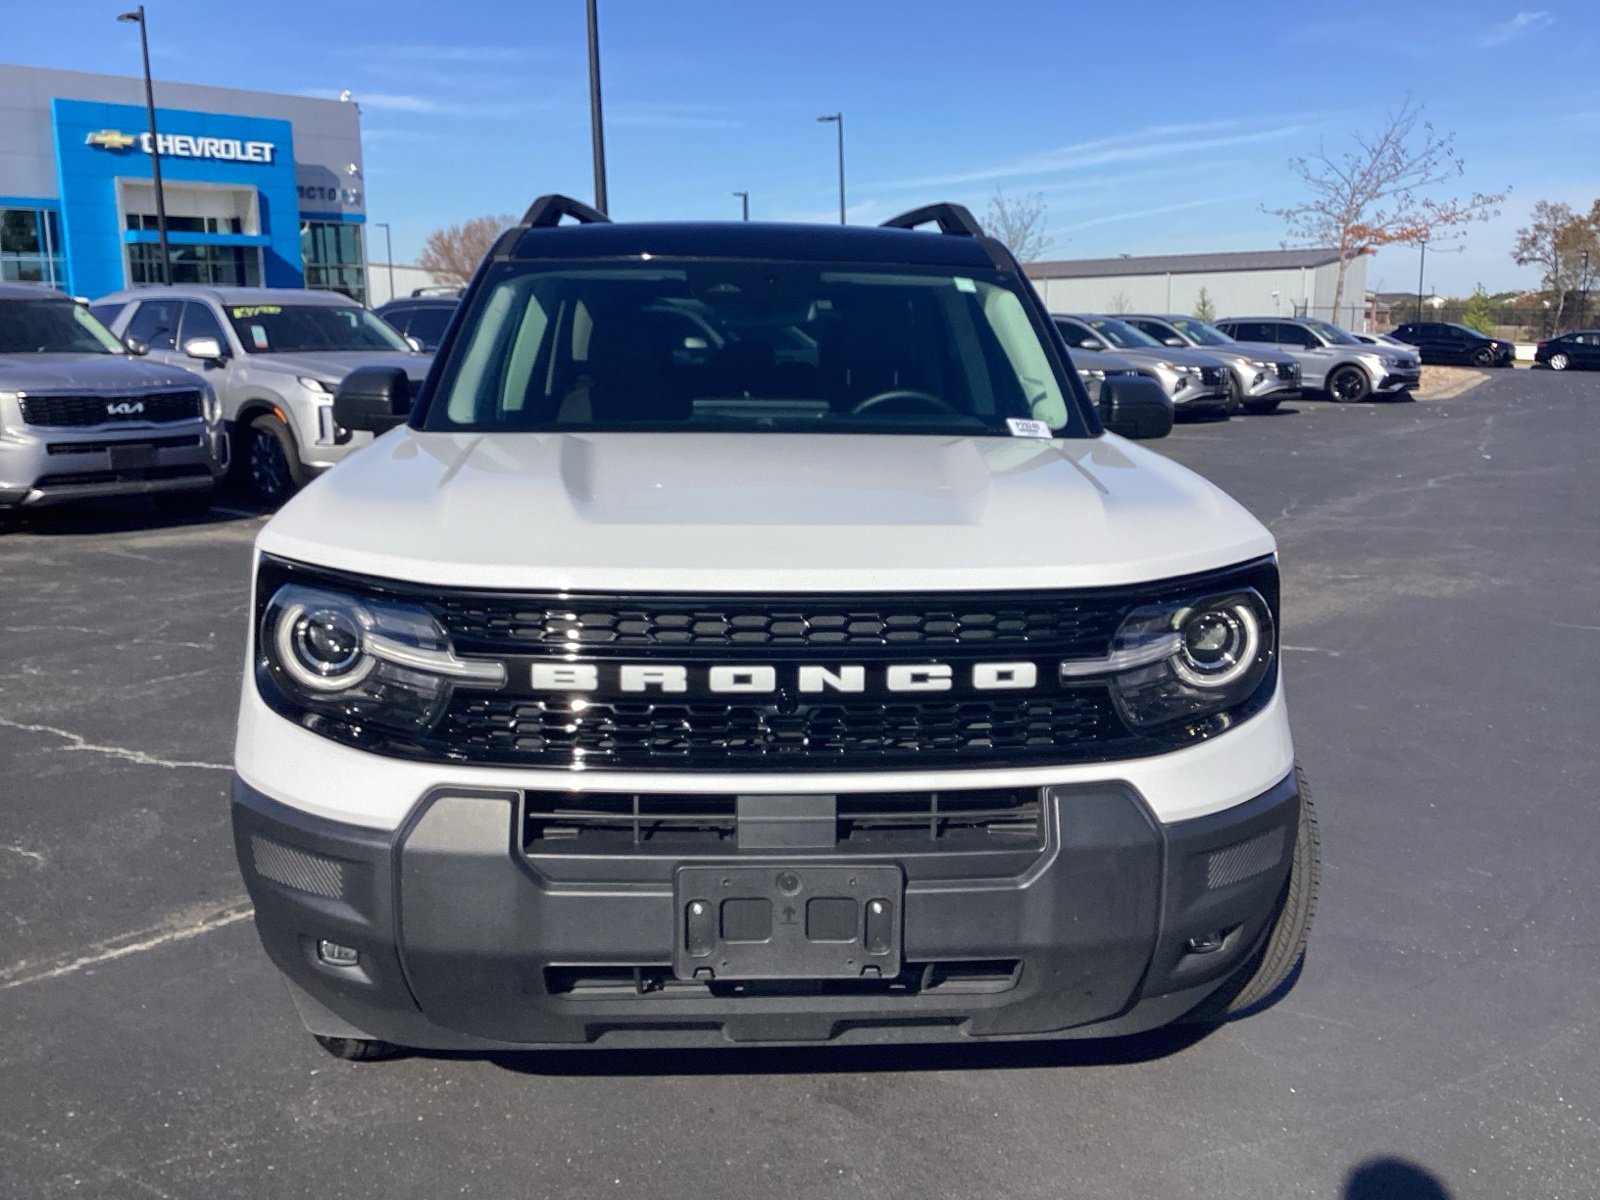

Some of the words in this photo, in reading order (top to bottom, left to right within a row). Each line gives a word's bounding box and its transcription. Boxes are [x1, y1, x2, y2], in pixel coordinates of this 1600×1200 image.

[140, 132, 274, 162] CHEVROLET
[107, 402, 144, 415] KIA
[531, 662, 1037, 693] BRONCO
